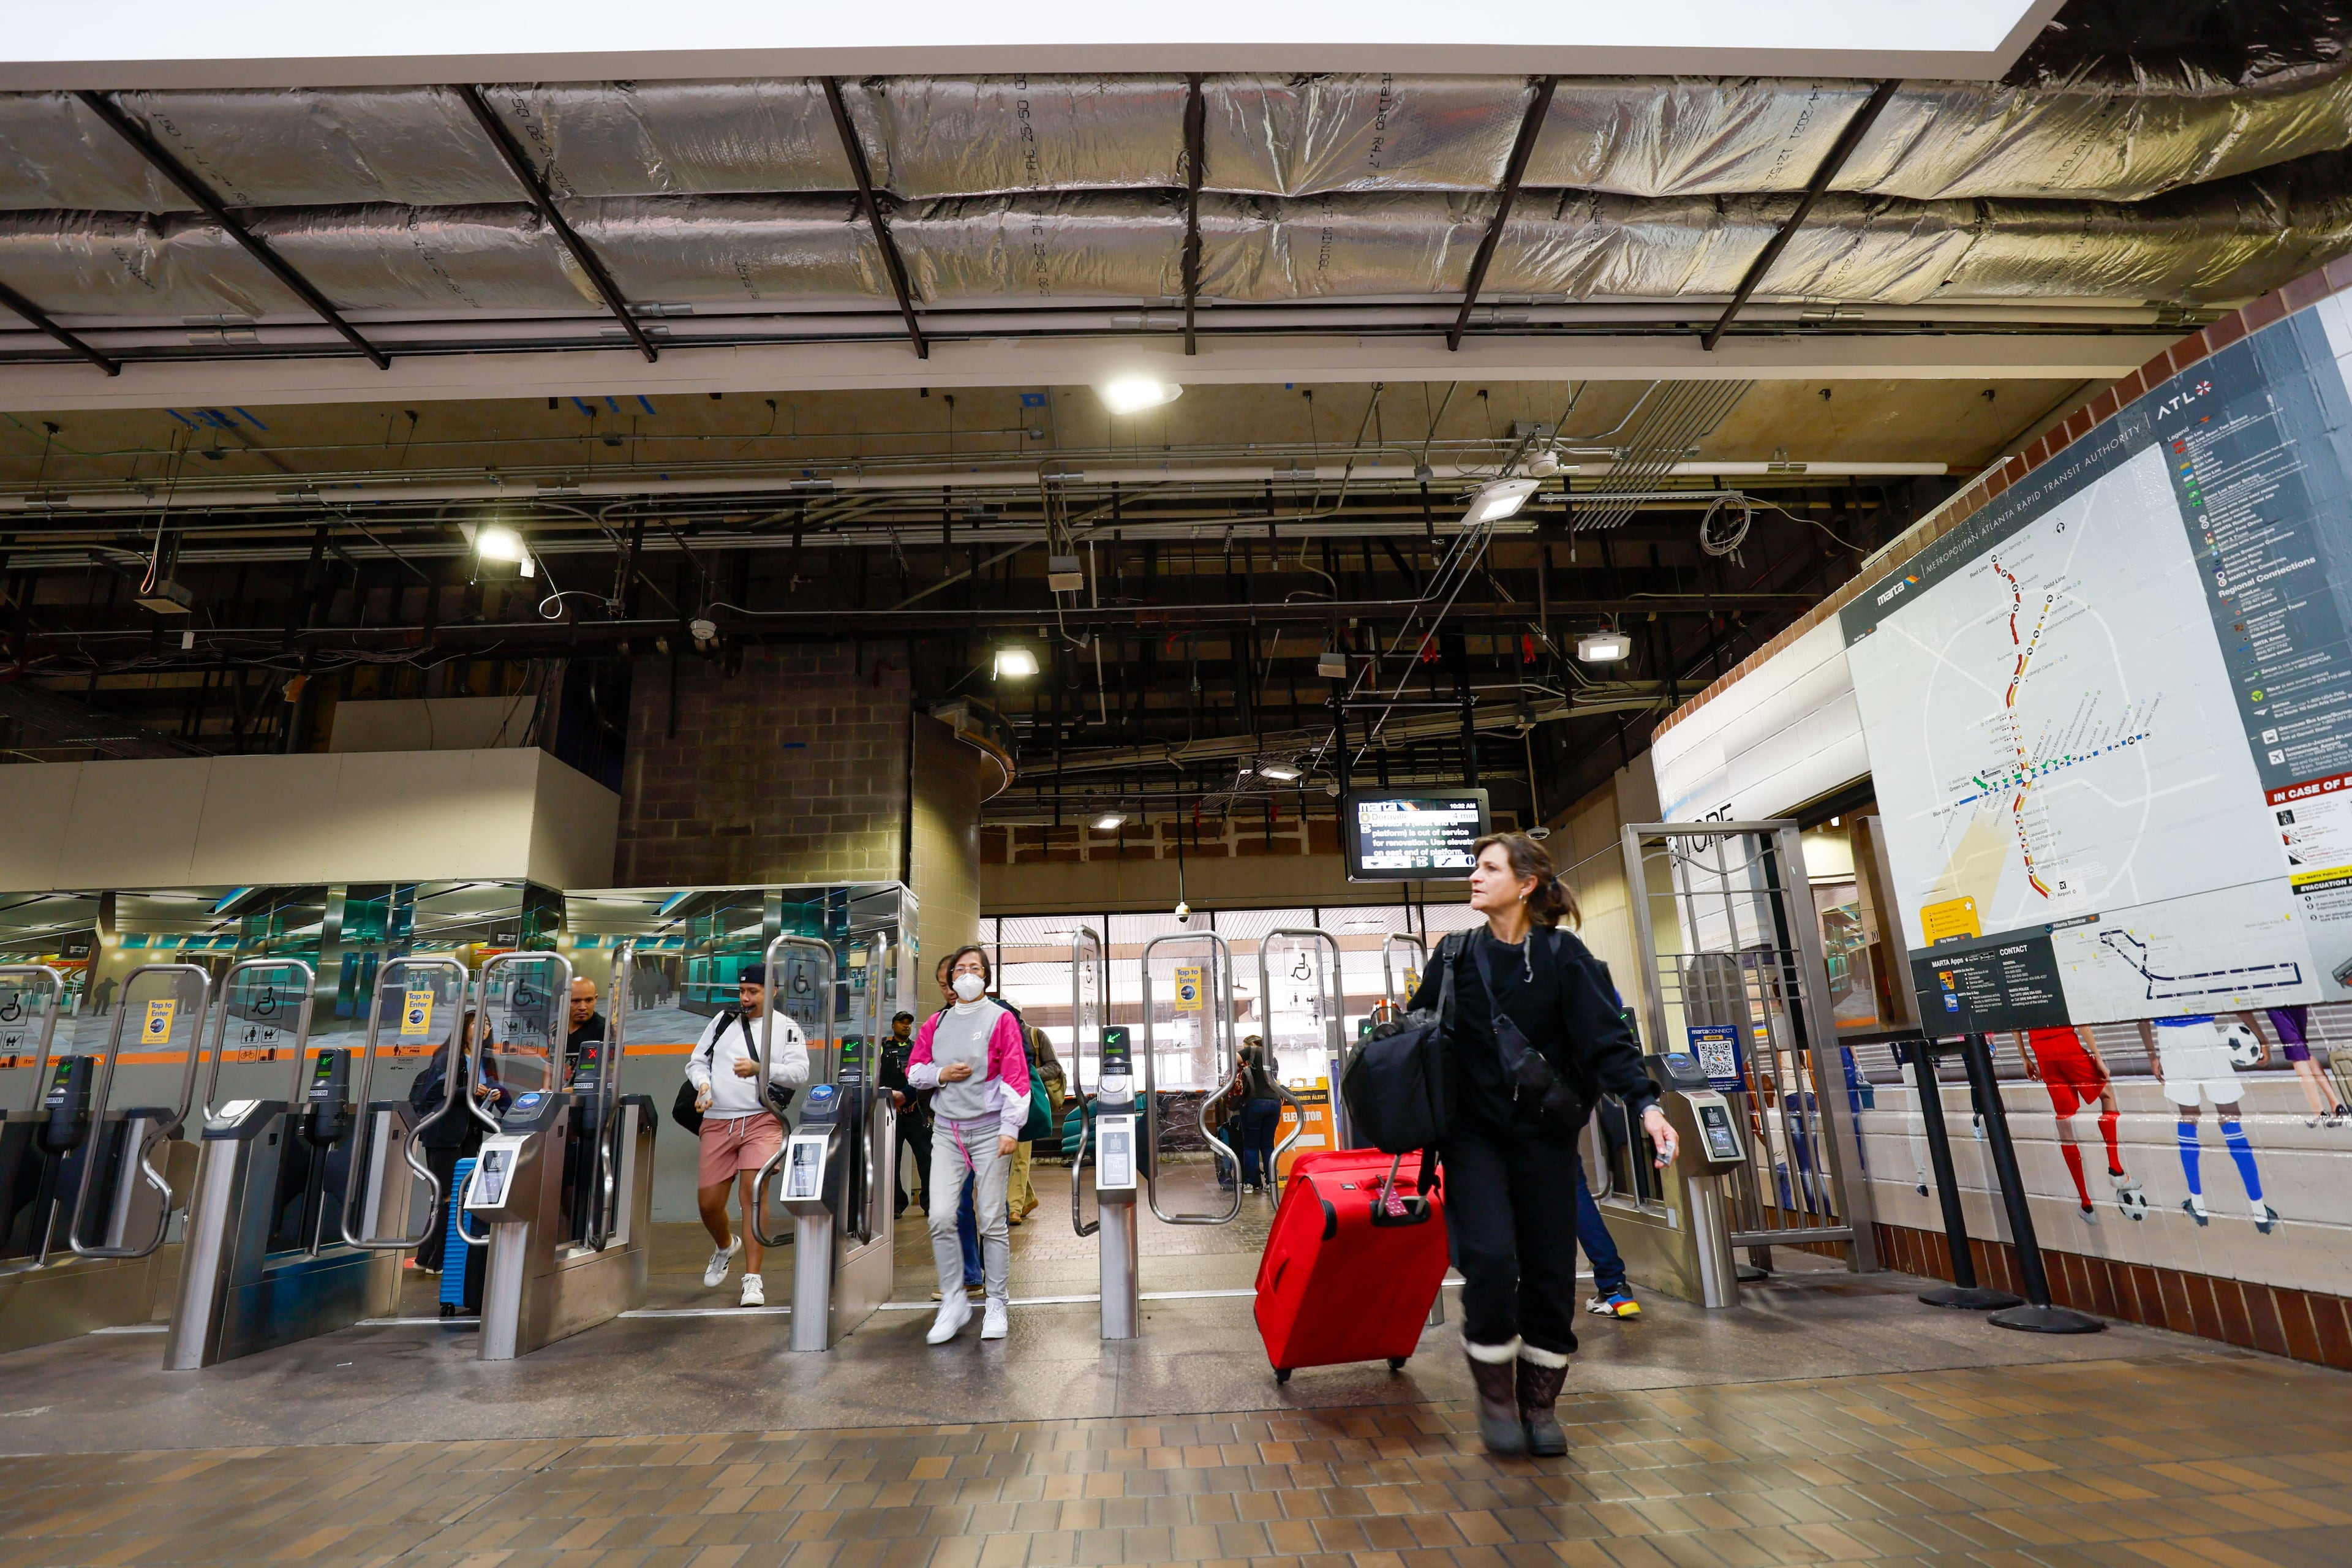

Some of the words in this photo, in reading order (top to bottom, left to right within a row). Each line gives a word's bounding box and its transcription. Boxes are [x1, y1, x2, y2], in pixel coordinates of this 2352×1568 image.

[2158, 392, 2195, 420] ATL
[2167, 426, 2190, 442] Legend
[1926, 532, 1979, 575] METROPOLITAN
[1981, 509, 2015, 536] ATLANTA
[2017, 491, 2041, 511] RAPID
[2043, 463, 2080, 494] TRANSIT
[2085, 423, 2139, 467] AUTHORITY
[2009, 561, 2020, 570] Sandy
[2020, 552, 2034, 564] Springs
[1969, 569, 1979, 578] Red
[1979, 564, 1988, 574] Line
[2218, 578, 2255, 598] Regional
[2256, 557, 2316, 582] Connections
[2043, 581, 2054, 590] Gold
[2054, 575, 2066, 585] Line
[1877, 581, 1905, 606] marta
[2056, 586, 2071, 597] Doraville
[2277, 646, 2293, 655] served
[2100, 726, 2110, 744] Decatur
[2274, 792, 2286, 802] IN
[2288, 784, 2320, 798] CASE
[2323, 779, 2340, 791] OF
[1359, 802, 1397, 812] marta
[1372, 829, 1408, 838] platform)
[2301, 879, 2347, 892] EVACUATION
[2053, 919, 2067, 929] Atlanta
[2000, 944, 2027, 956] CONTACT
[1931, 959, 1950, 968] MARTA
[1951, 957, 1964, 966] Apps
